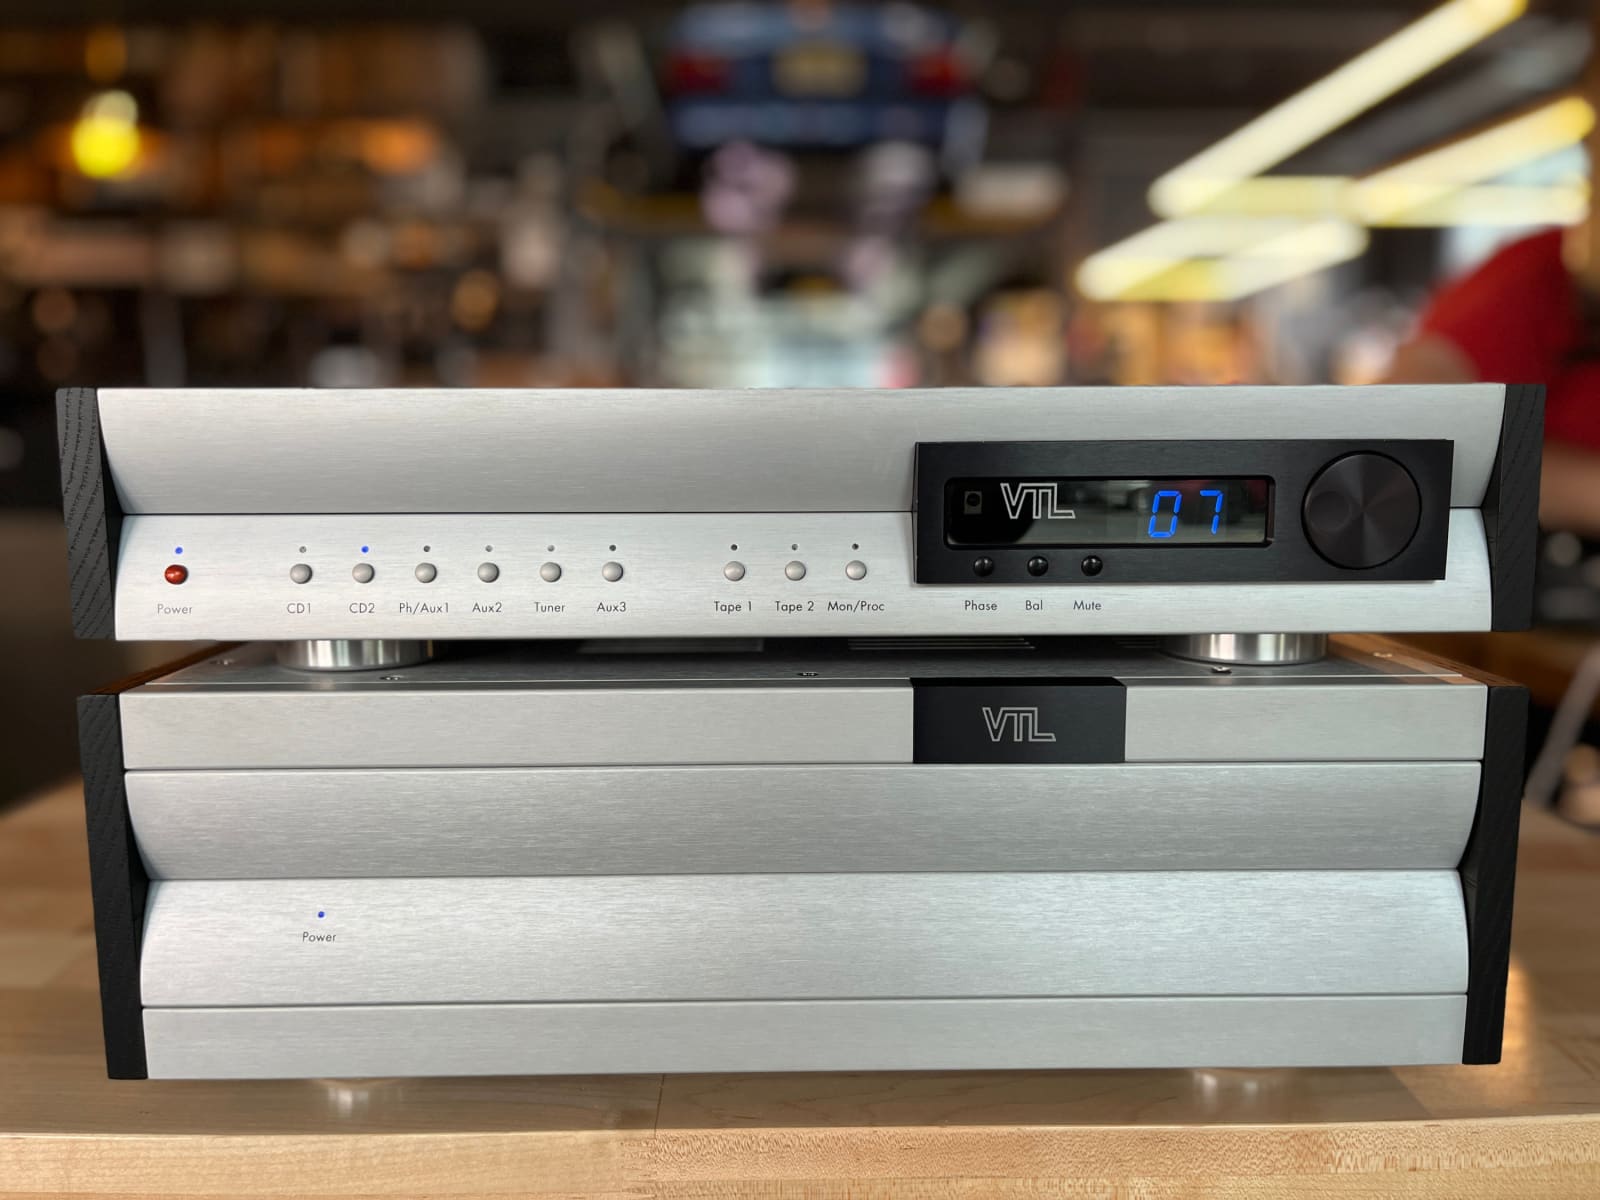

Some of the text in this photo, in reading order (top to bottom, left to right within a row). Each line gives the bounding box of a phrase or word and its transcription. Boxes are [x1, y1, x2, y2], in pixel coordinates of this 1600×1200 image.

[1000, 483, 1075, 519] VTL
[1148, 490, 1223, 538] 07
[157, 603, 193, 615] Power
[286, 602, 311, 614] CD1
[349, 602, 375, 614] CD2
[399, 602, 449, 615] Ph/Aux1
[472, 601, 502, 613] Aux2
[534, 601, 565, 613] Tuner
[596, 601, 627, 613] Aux3
[713, 600, 742, 615] Tape
[775, 600, 815, 614] Tape 2
[827, 599, 885, 613] Mon/Proc
[964, 599, 998, 611] Phase
[1025, 599, 1043, 611] Bal
[1072, 600, 1102, 611] Mute
[983, 707, 1056, 742] VTL
[302, 931, 337, 943] Power
